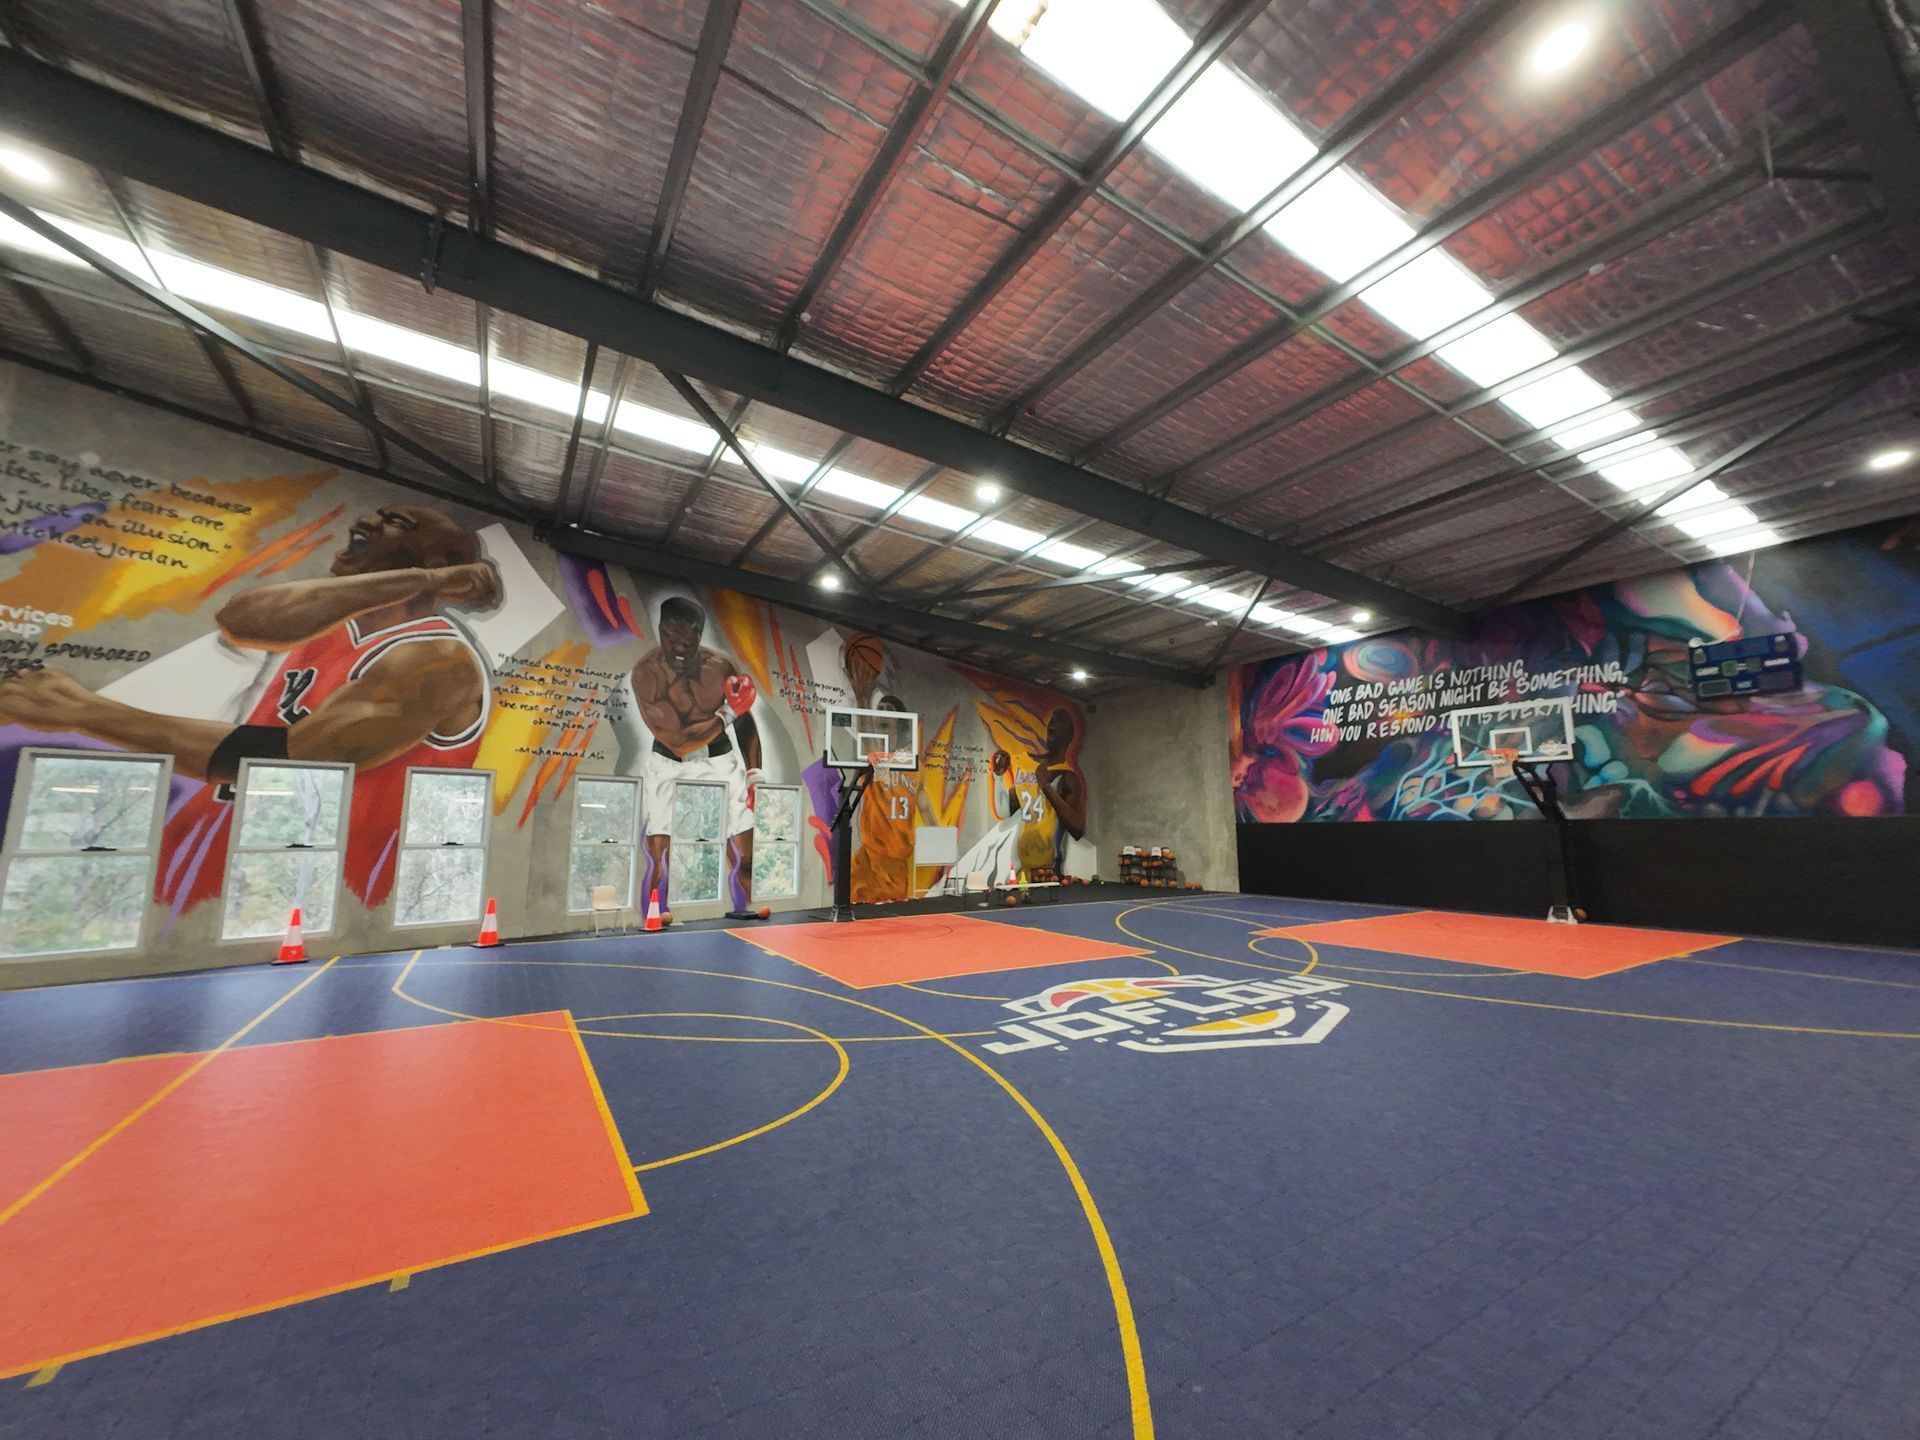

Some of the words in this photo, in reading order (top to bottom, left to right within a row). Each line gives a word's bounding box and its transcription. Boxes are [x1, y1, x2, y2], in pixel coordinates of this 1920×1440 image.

[119, 492, 178, 519] fears
[191, 514, 225, 531] are
[169, 482, 253, 516] because
[544, 663, 572, 677] every
[1322, 707, 1344, 725] ONE
[1348, 700, 1375, 723] BAD
[1378, 692, 1437, 718] SEASON
[1439, 683, 1485, 707] MIGHT
[1487, 679, 1510, 698] BE
[1355, 682, 1385, 702] BAD
[1387, 675, 1425, 695] GAME
[1428, 672, 1445, 691] IS
[1310, 727, 1335, 744] HOW
[1339, 725, 1362, 742] YOU
[1366, 714, 1437, 739] RESPOND
[890, 796, 909, 820] 13
[1021, 790, 1044, 823] 24
[981, 975, 1350, 1054] JOFLOW
